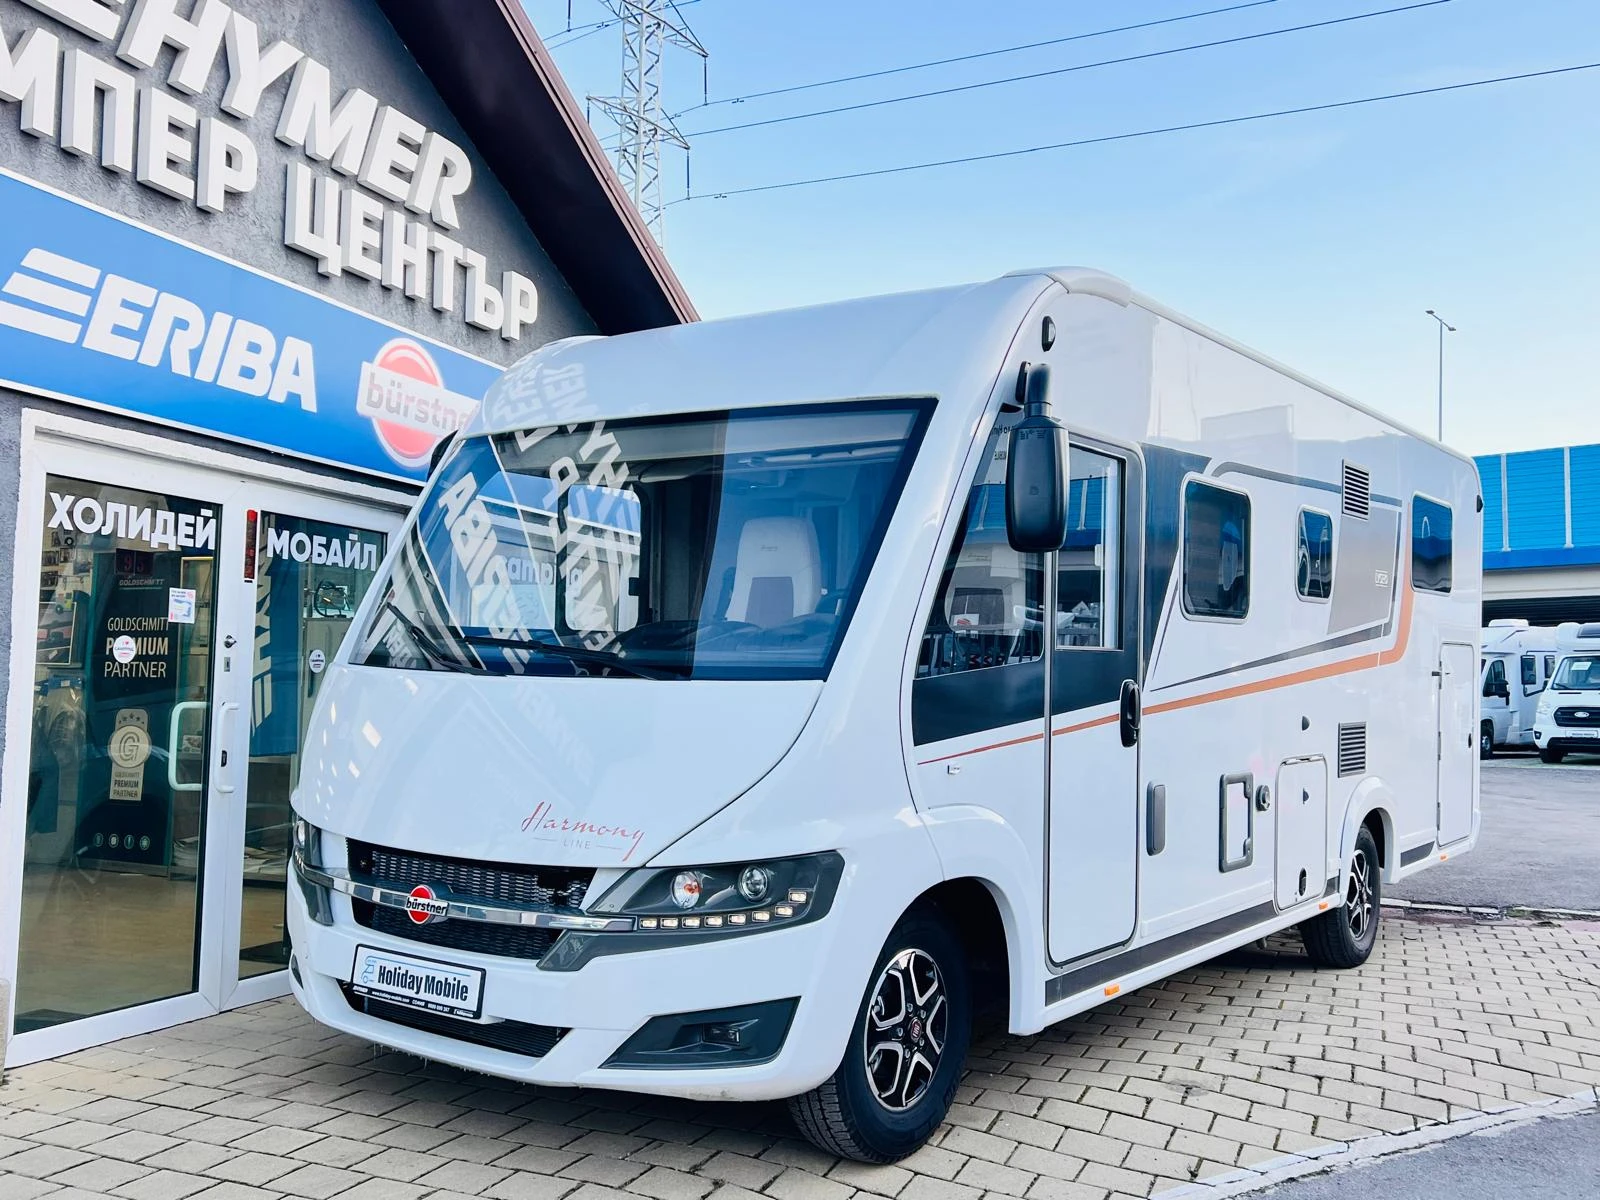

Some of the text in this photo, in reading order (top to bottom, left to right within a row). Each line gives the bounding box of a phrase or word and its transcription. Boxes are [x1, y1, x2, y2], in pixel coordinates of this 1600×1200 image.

[285, 163, 538, 341] ЦЕНТЪР
[82, 273, 317, 413] ERIBA
[48, 491, 216, 550] ХОЛИДЕЙ
[266, 527, 377, 572] МОБАЙЛ
[107, 617, 169, 632] GOLDSCHMITT
[105, 637, 169, 656] PMIUM
[104, 661, 167, 678] PARTNER
[521, 801, 646, 862] Harmony
[563, 838, 591, 850] LINE
[406, 897, 446, 914] bürstner
[378, 965, 469, 1002] Holiday Mobile
